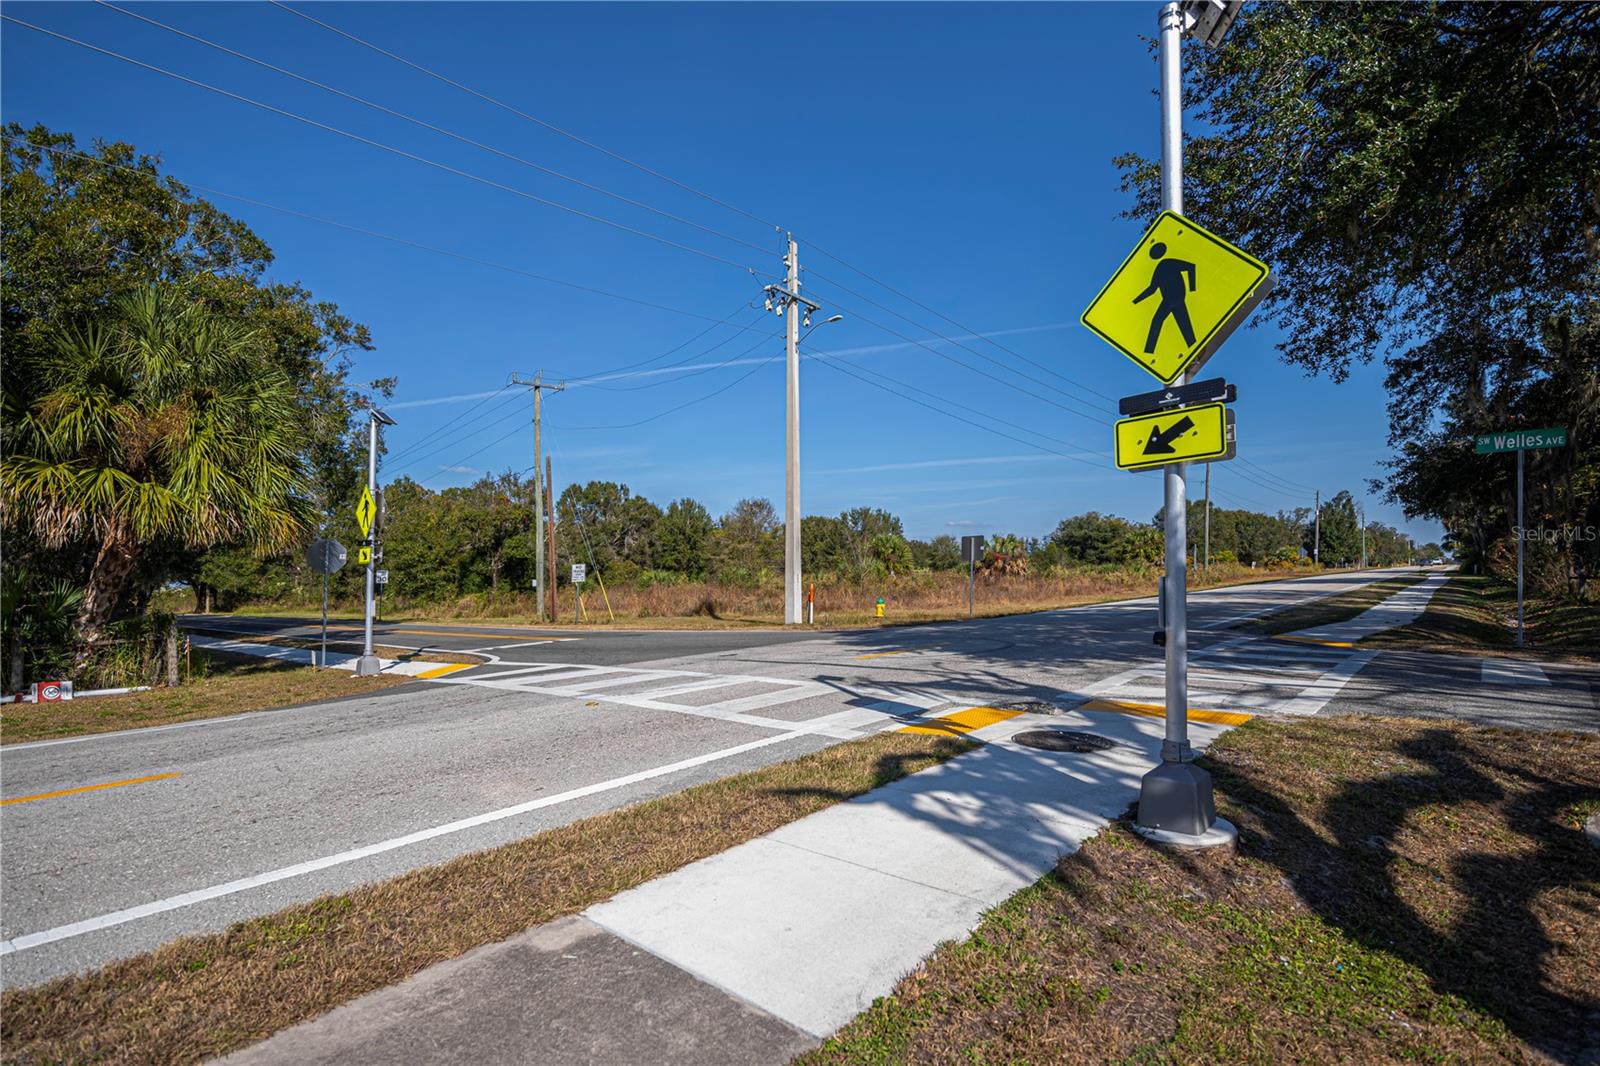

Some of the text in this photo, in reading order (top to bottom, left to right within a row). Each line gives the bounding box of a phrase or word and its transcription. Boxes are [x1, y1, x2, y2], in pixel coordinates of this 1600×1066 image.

[1478, 434, 1565, 450] SW Welles AVE
